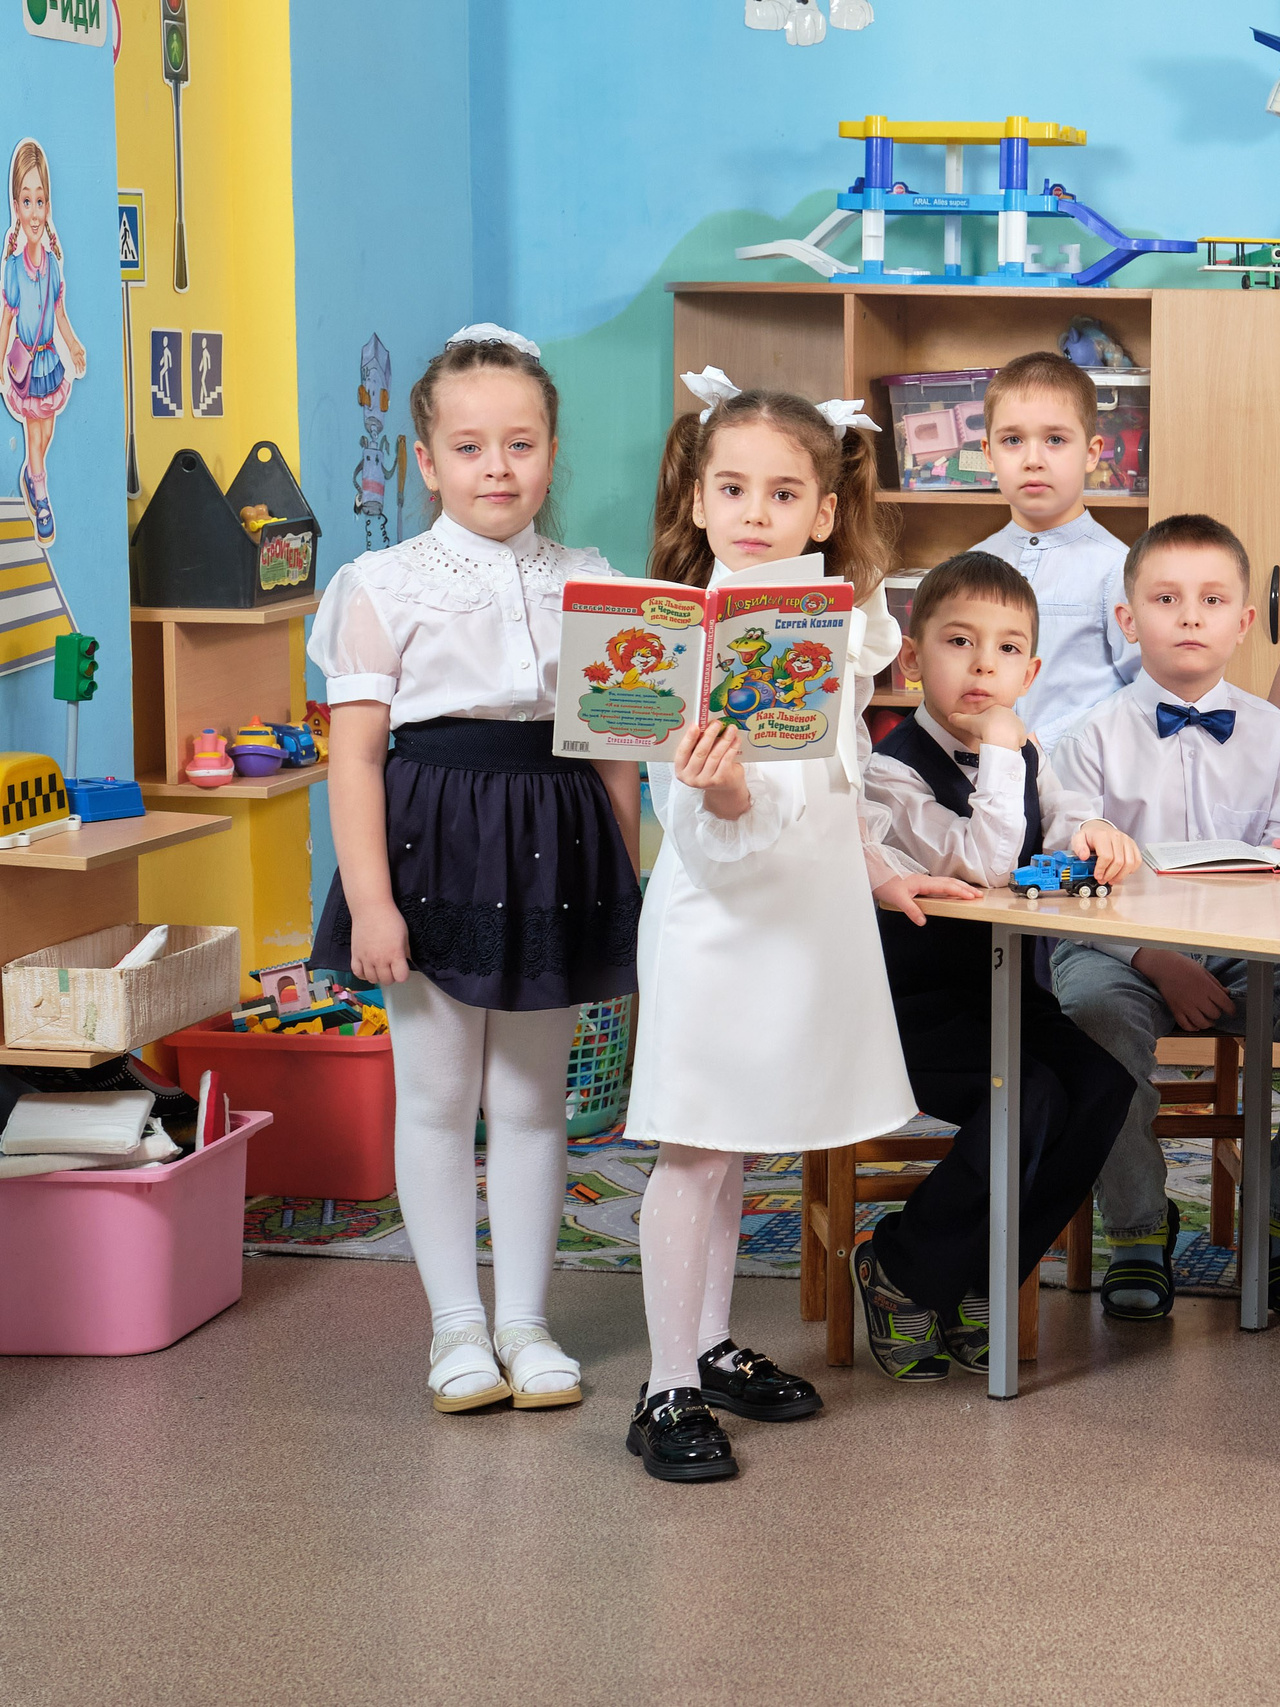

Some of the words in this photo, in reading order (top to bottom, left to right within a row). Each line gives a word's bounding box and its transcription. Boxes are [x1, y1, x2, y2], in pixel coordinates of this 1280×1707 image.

[261, 538, 304, 571] СТРОИТЕЛЬ
[649, 598, 663, 606] Как
[658, 605, 691, 617] Черепаха
[756, 711, 775, 721] Как
[776, 711, 817, 723] Львёнок
[768, 720, 810, 732] Черепаха
[754, 730, 777, 740] пели
[779, 730, 817, 740] песенку
